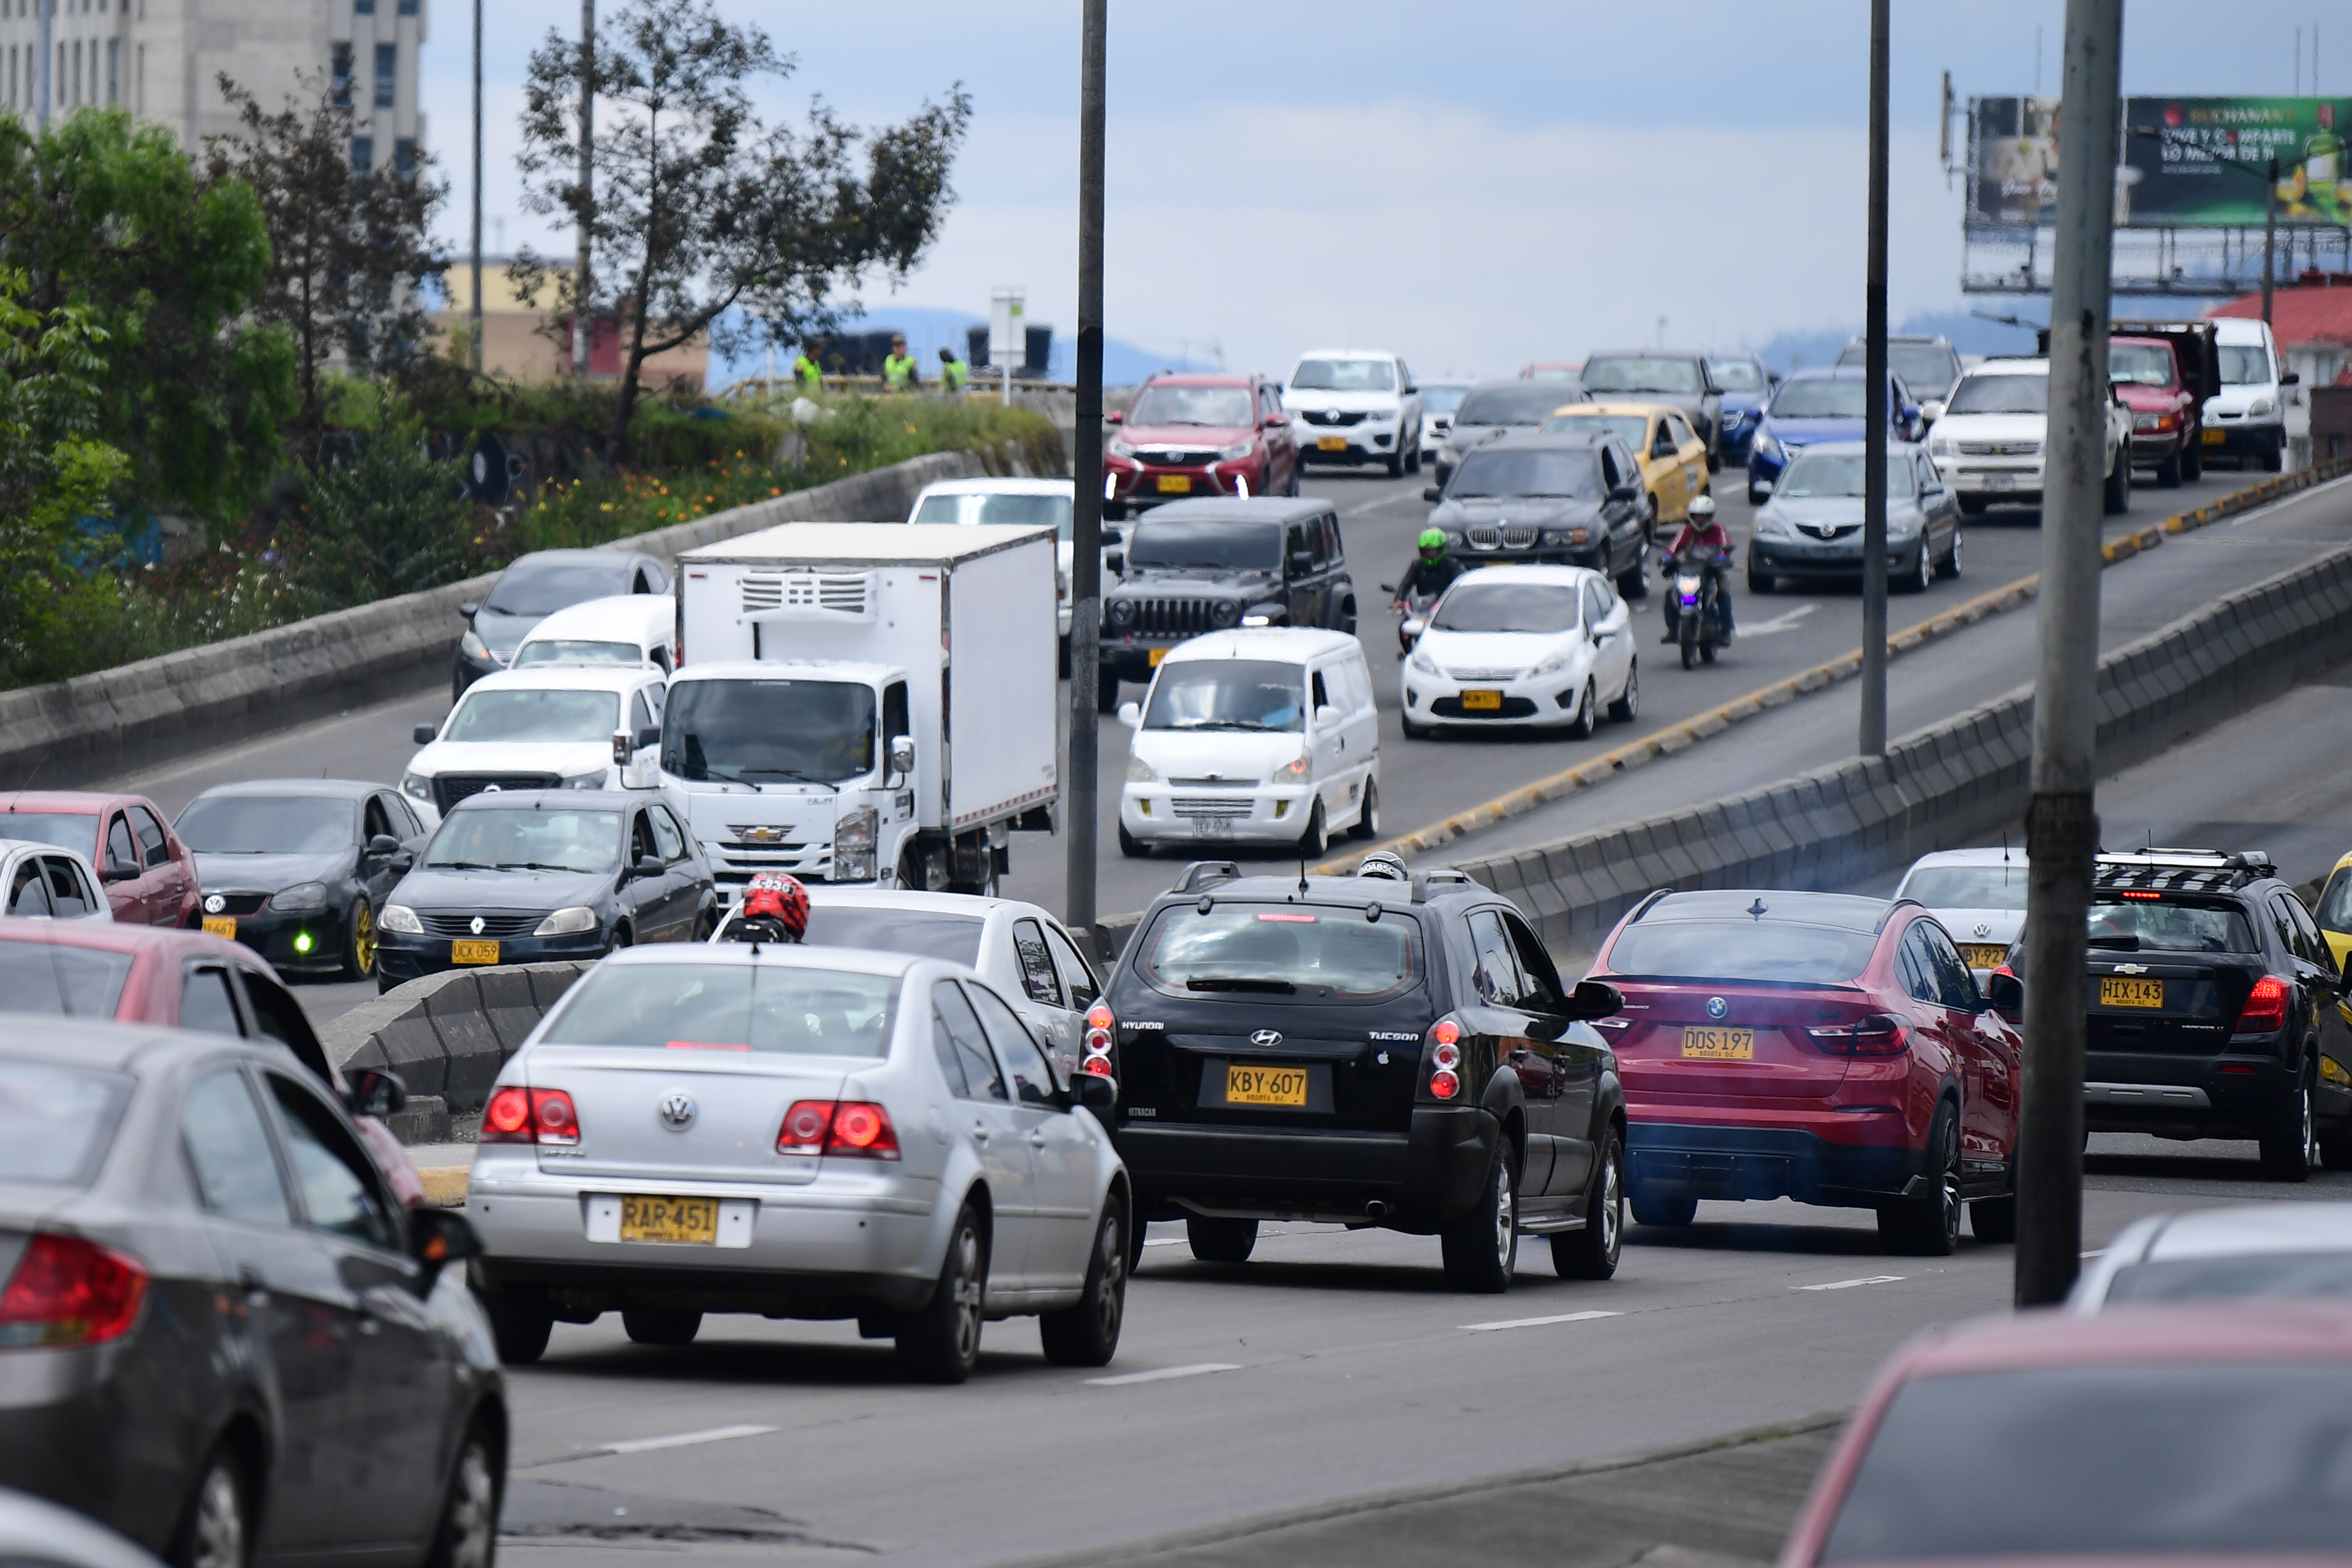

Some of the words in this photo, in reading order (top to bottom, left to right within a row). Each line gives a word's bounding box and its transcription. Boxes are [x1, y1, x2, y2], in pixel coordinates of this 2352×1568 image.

[1361, 863, 1395, 875] NOA85C
[454, 944, 473, 957] UCK
[477, 944, 497, 957] 059
[2103, 982, 2130, 998] HIX
[2135, 983, 2160, 1000] 143
[1122, 1021, 1164, 1030] HYUNDAI
[1368, 1031, 1420, 1041] TUCSON
[1685, 1030, 1716, 1050] DOS
[1722, 1032, 1752, 1051] 197
[1230, 1071, 1265, 1093] KBY
[1270, 1073, 1305, 1095] 607
